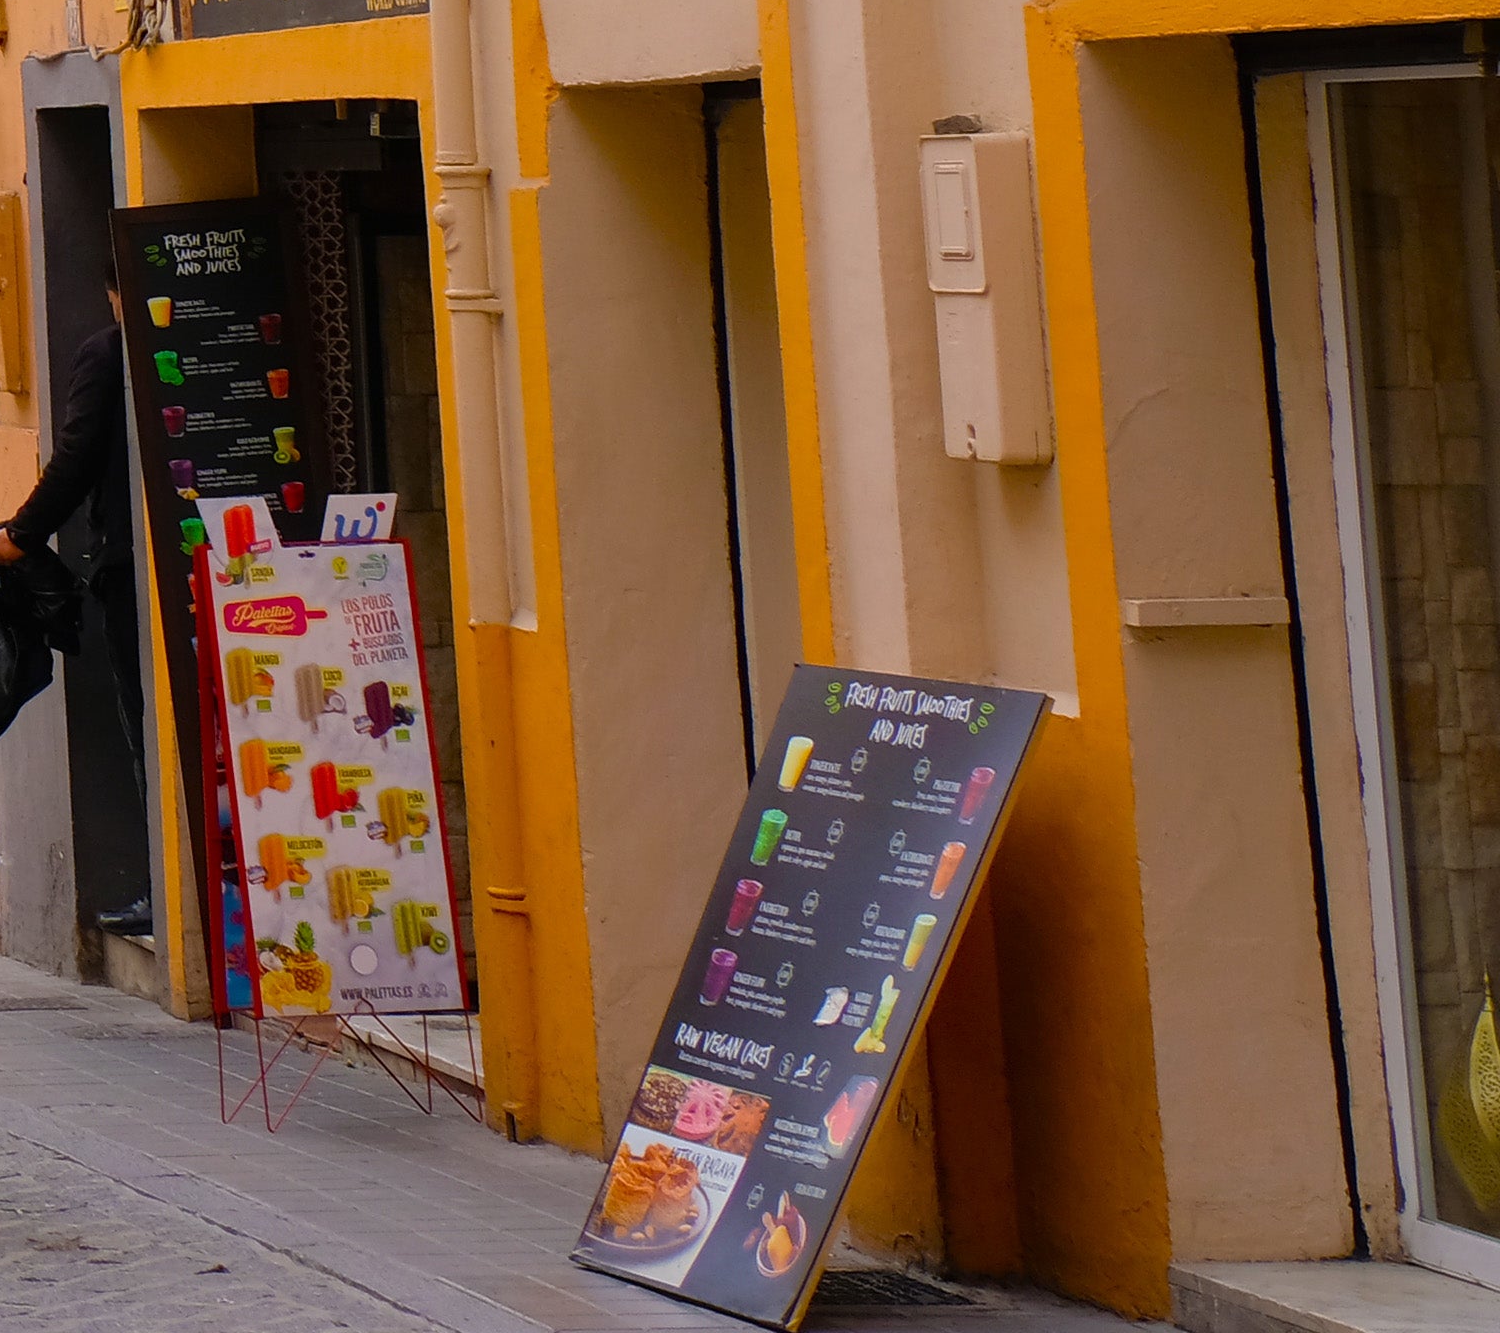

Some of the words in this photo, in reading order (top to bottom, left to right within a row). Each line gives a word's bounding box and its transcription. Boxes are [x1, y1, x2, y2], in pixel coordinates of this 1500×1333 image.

[163, 233, 200, 251] FRESH
[205, 229, 246, 247] FRUITS
[174, 244, 240, 263] SMOOTHIES
[176, 261, 201, 276] AND
[205, 258, 241, 275] JUICES
[341, 598, 360, 614] LOS
[362, 594, 393, 610] POLOS
[354, 610, 401, 636] FRUTA
[353, 653, 369, 666] DEL
[370, 647, 409, 664] PLANETA
[323, 670, 342, 681] COCO
[844, 682, 879, 710] FRESH
[878, 686, 916, 715] FRUITS
[915, 692, 974, 723] SMOOTHIES
[869, 719, 894, 743] AND
[892, 722, 929, 749] JUICES
[675, 1022, 702, 1049] RAW
[703, 1030, 741, 1061] VEGAN
[741, 1039, 775, 1069] CAKES
